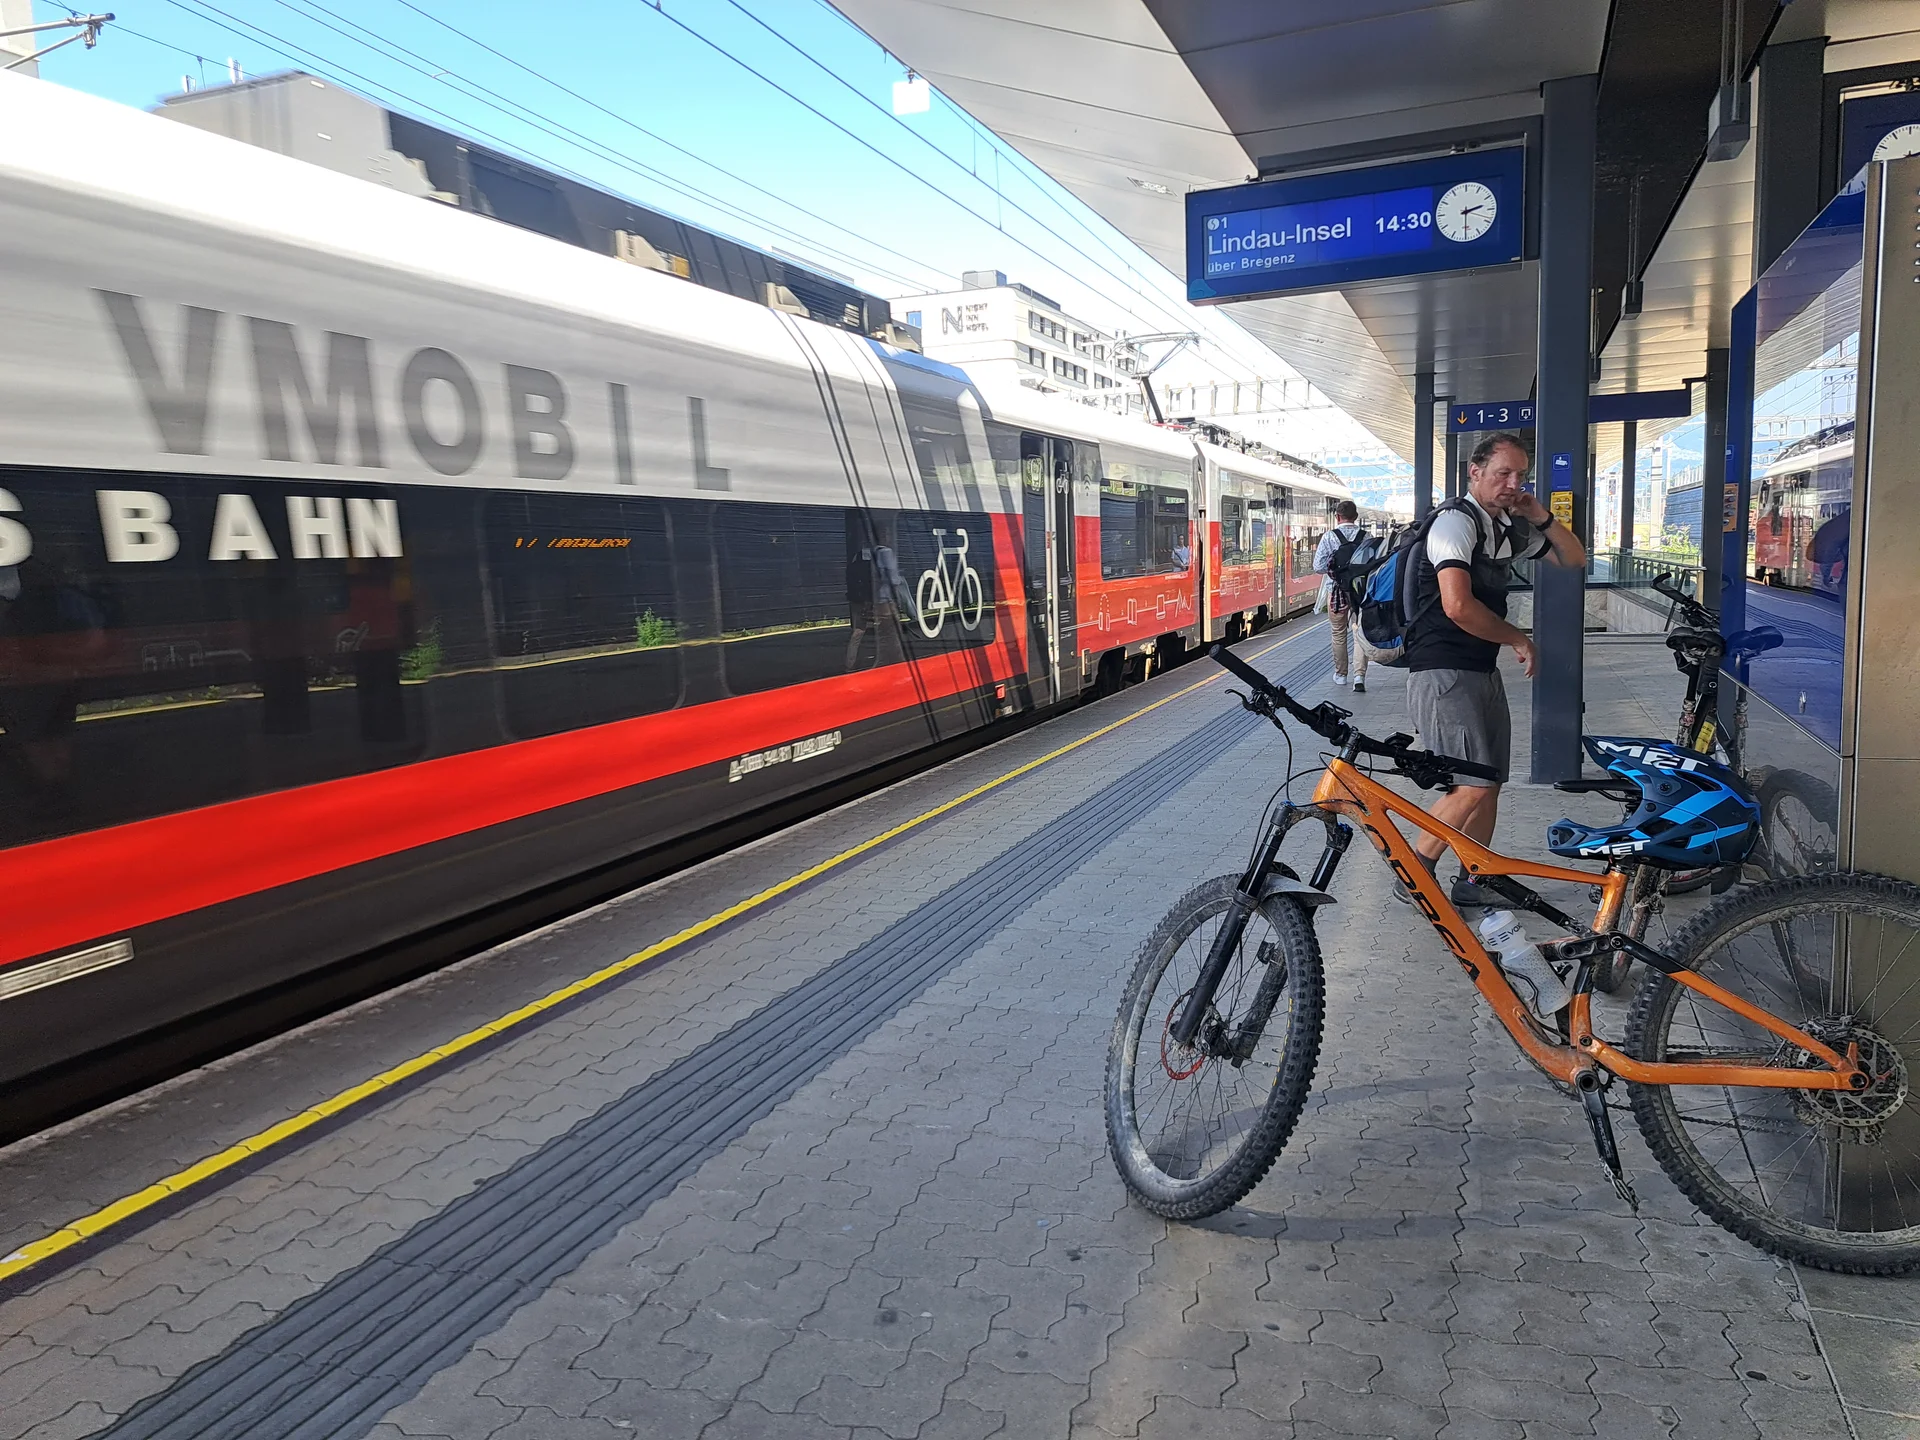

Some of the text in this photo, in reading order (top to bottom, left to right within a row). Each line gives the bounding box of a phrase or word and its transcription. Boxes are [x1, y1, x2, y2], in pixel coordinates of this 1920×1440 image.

[1208, 211, 1432, 255] Lindau-Insel 14:30
[1207, 254, 1295, 273] über Bregenz
[95, 489, 404, 562] BAHN
[1597, 740, 1709, 772] MET
[1579, 840, 1651, 857] MET
